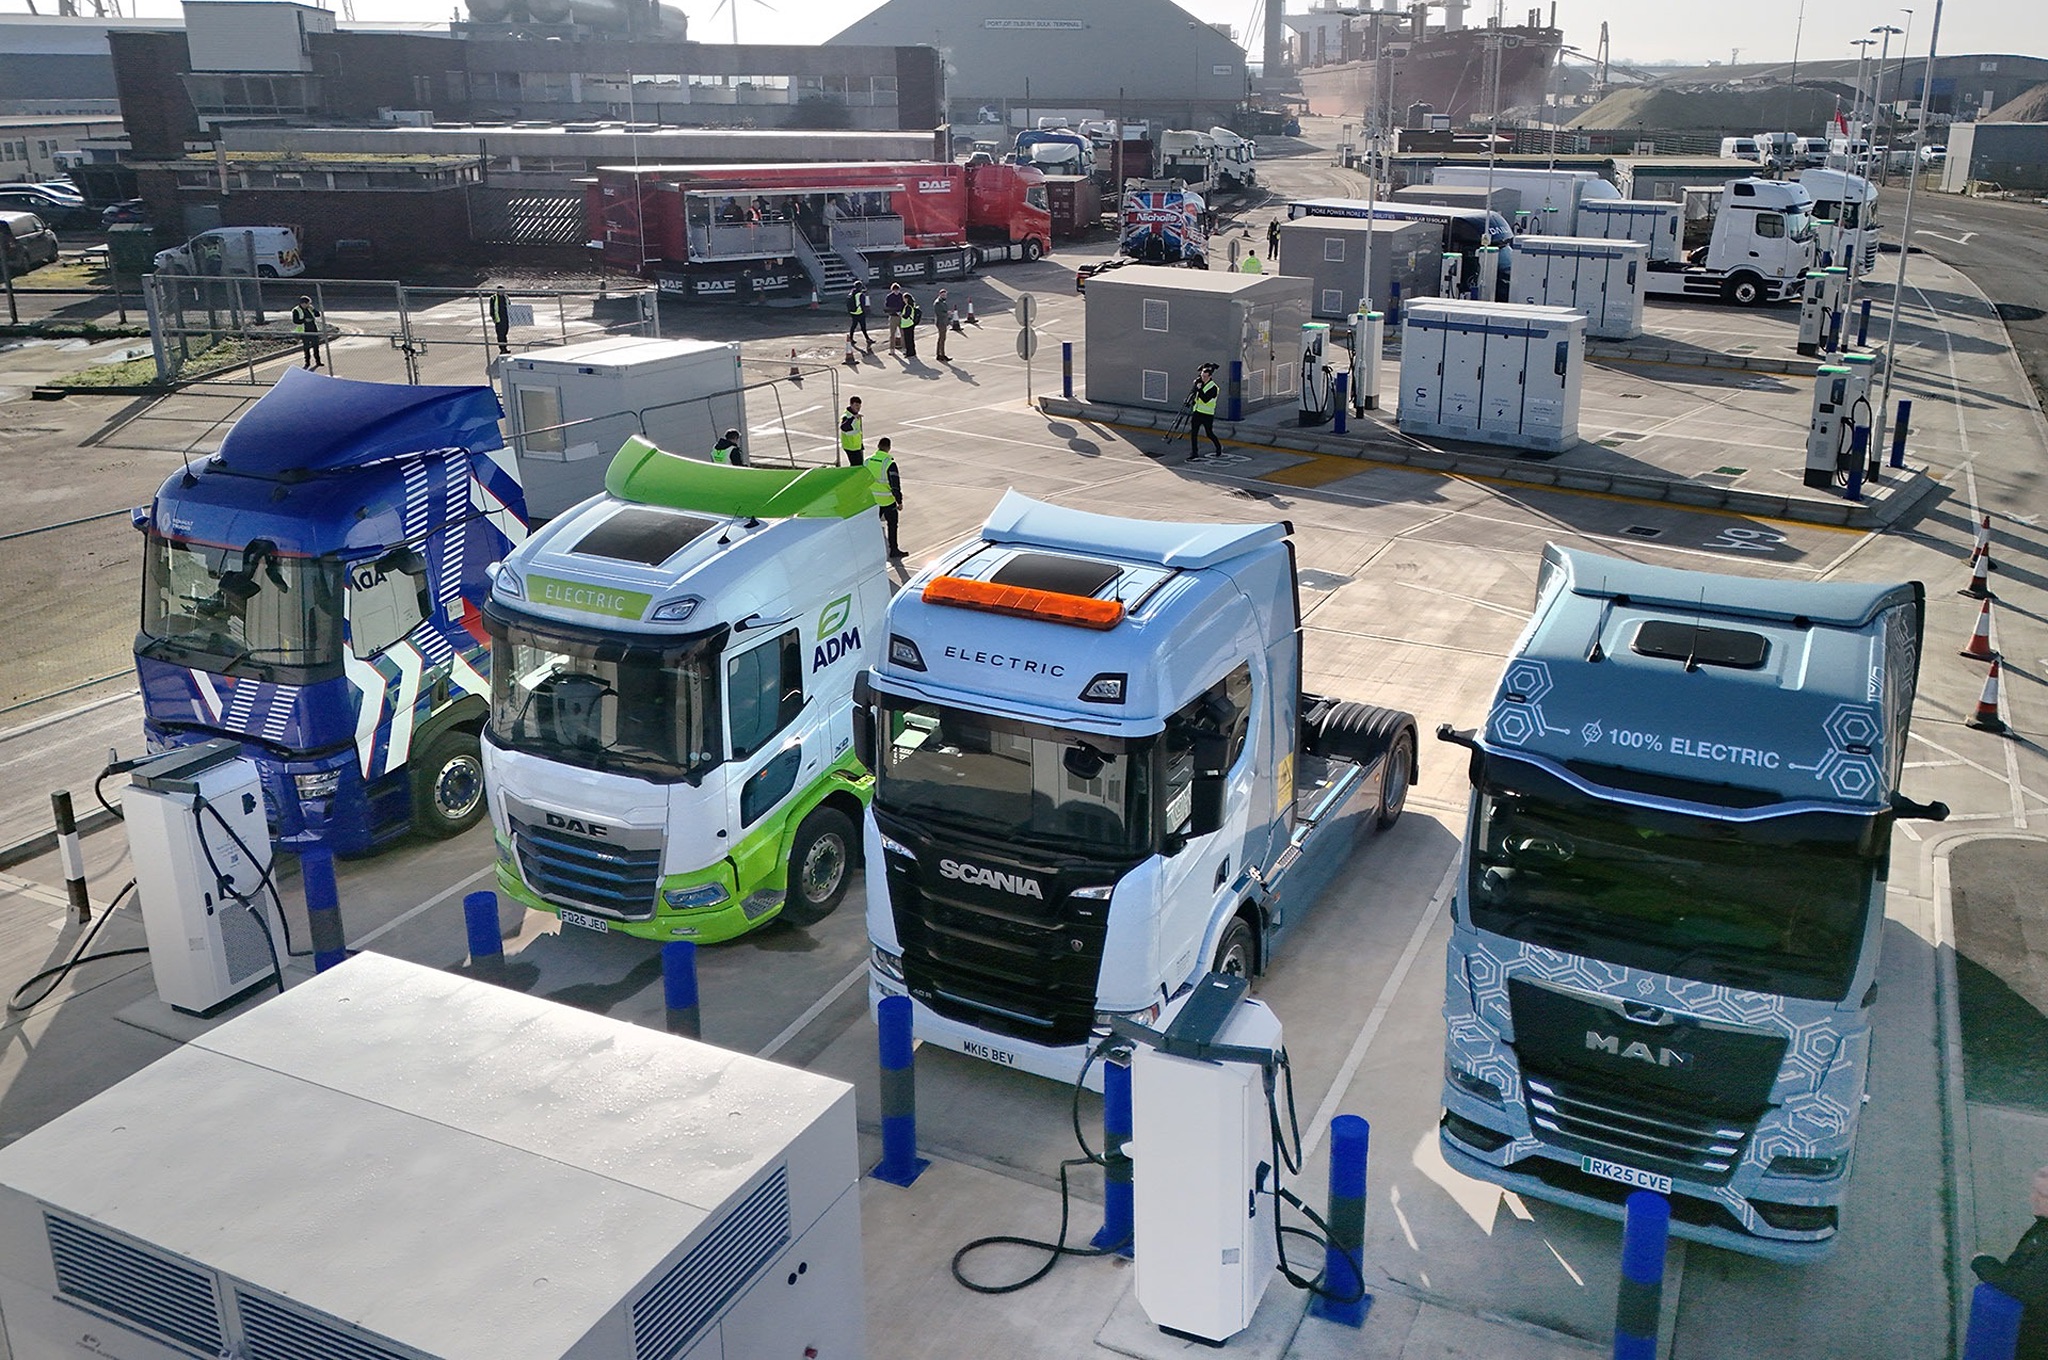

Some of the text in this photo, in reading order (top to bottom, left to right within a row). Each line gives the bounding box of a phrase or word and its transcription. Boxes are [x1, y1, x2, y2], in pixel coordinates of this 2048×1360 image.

[919, 180, 951, 190] DAF
[1136, 213, 1178, 222] Nicholls
[1311, 207, 1326, 215] MORE
[1327, 208, 1345, 217] POWER
[1346, 210, 1361, 218] MORE
[893, 262, 925, 273] DAF
[936, 258, 960, 269] DAF
[659, 278, 684, 290] DAF
[697, 280, 736, 290] DAF
[752, 276, 788, 288] DAF
[1702, 527, 1788, 552] 6A
[545, 584, 625, 611] ELECTRIC
[812, 626, 862, 674] ADM
[944, 646, 1065, 677] ELECTRIC
[1609, 728, 1781, 769] 100% ELECTRIC
[545, 812, 608, 837] DAF
[939, 858, 1044, 900] SCANIA
[963, 1040, 1015, 1065] MK15 BEV
[1585, 1030, 1695, 1068] MAN
[1592, 1160, 1669, 1192] RK25 CVE
